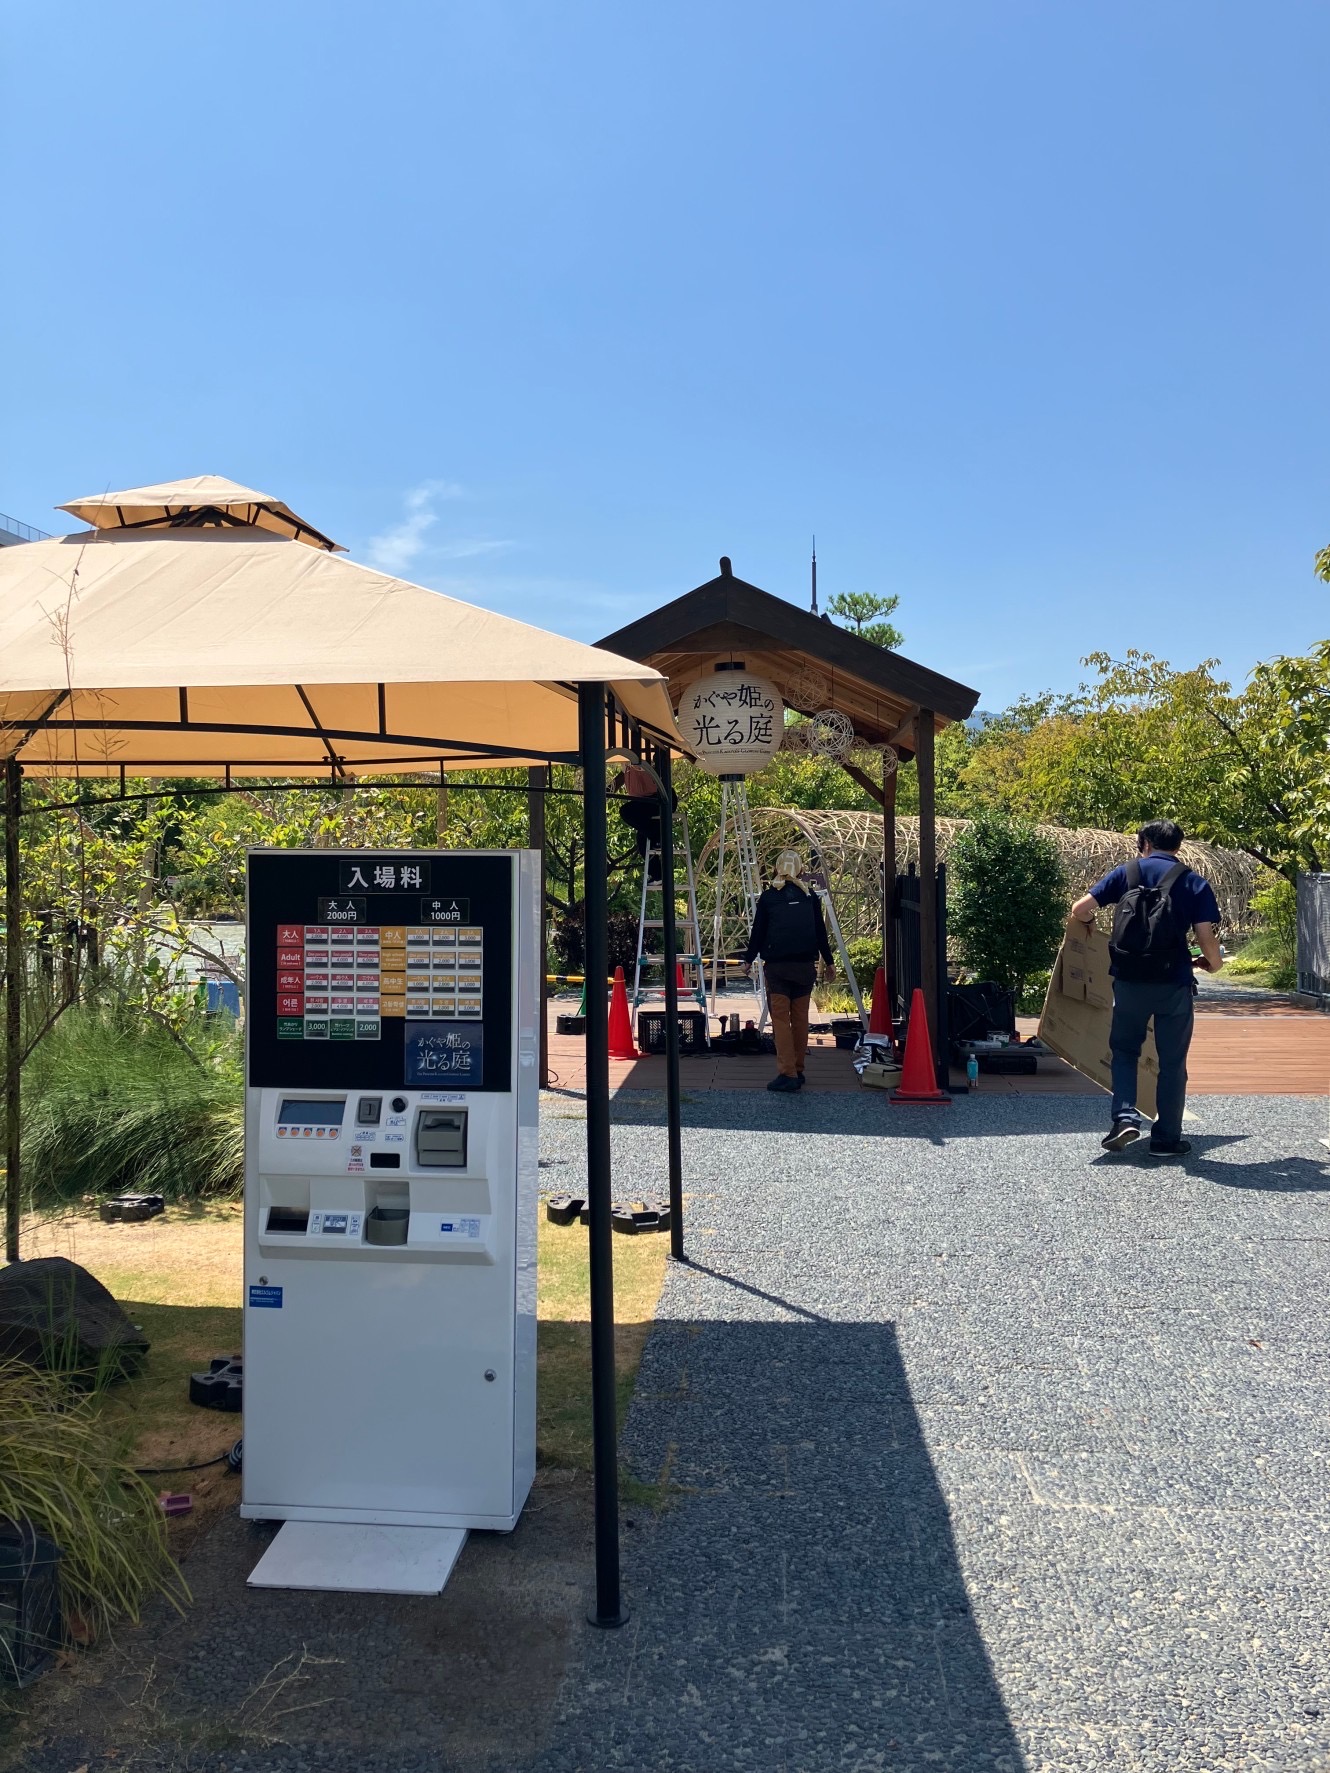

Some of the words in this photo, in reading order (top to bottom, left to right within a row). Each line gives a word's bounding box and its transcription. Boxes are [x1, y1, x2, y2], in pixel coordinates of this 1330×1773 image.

[693, 684, 775, 711] かぐや姫の
[693, 713, 773, 746] 光る庭
[347, 866, 422, 888] 入場料
[328, 900, 355, 910] 大人
[432, 901, 458, 910] 中人
[327, 912, 356, 920] 2000円
[431, 912, 460, 920] 1000円
[282, 930, 299, 938] 大人
[385, 931, 401, 940] 中人
[282, 998, 298, 1008] 어른
[418, 1032, 471, 1049] かぐや姫の
[416, 1050, 472, 1070] 光る庭
